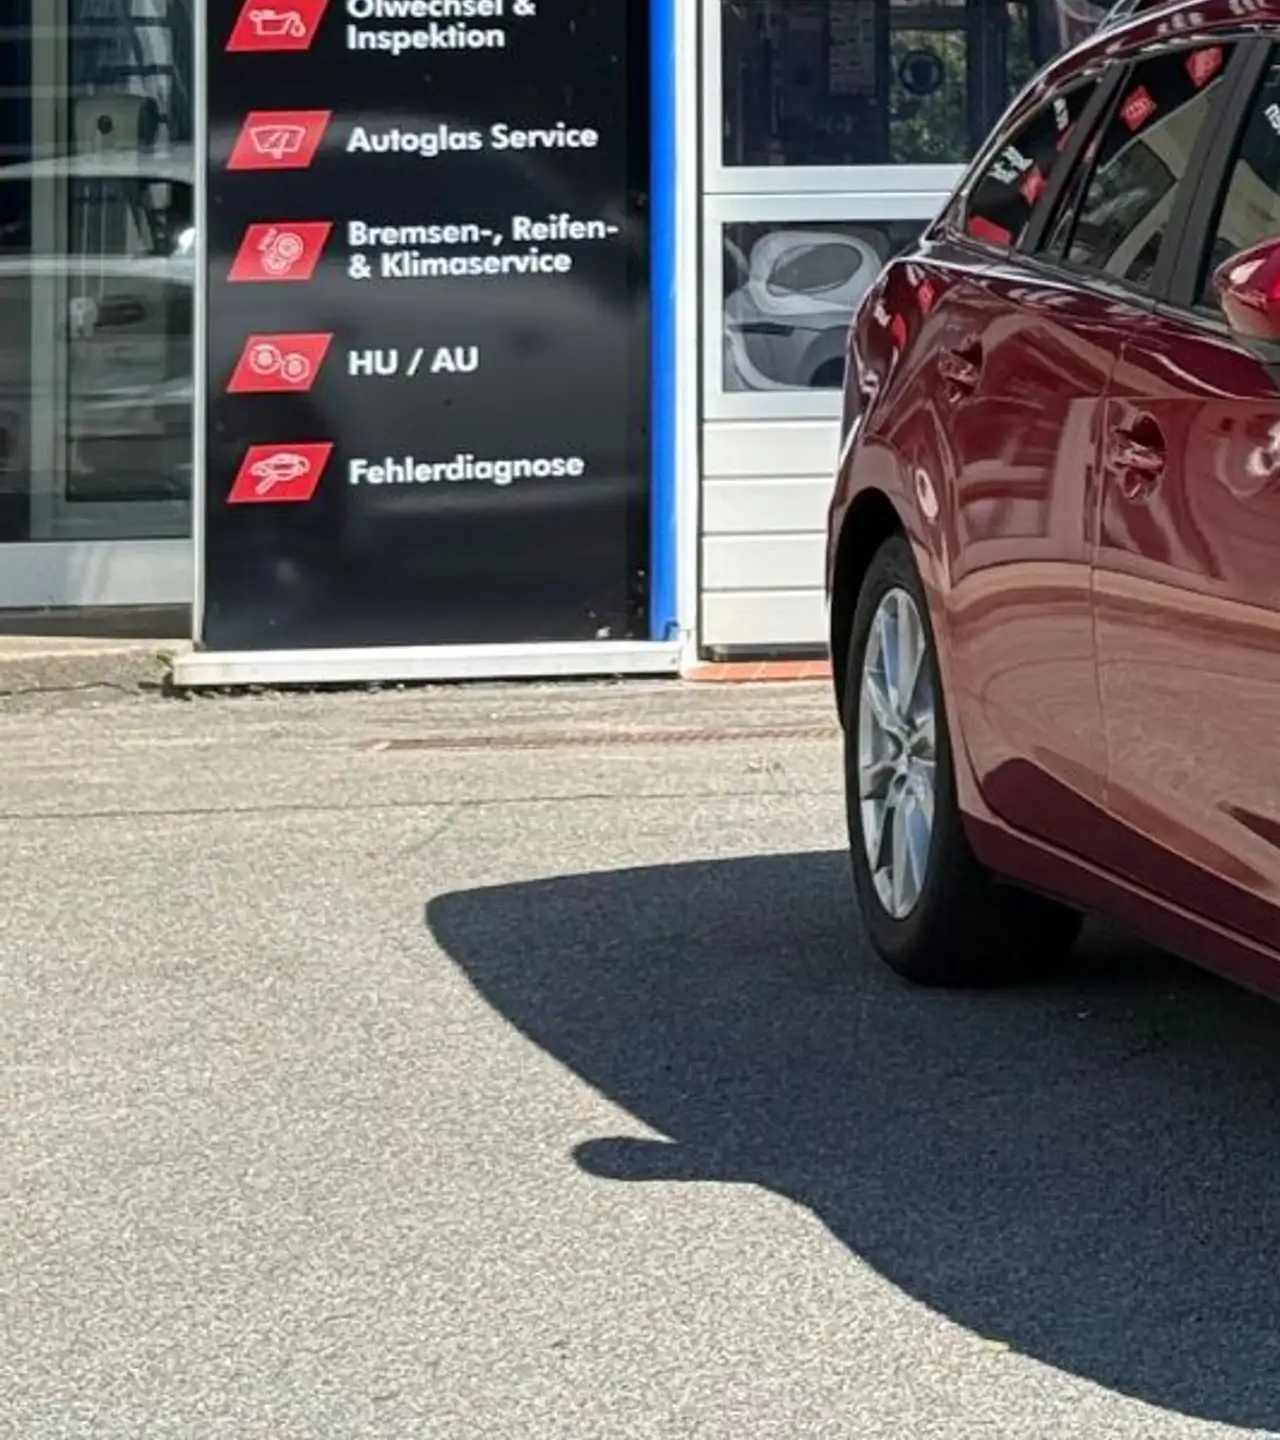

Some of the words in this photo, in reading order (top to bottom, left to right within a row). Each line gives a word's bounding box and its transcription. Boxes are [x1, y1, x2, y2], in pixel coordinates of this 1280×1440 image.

[347, 22, 505, 56] Inspektion
[346, 124, 483, 157] Autoglas
[490, 121, 599, 150] Service
[348, 220, 503, 246] Bremsen-,
[512, 213, 619, 241] Reifen-
[347, 253, 372, 280] &
[381, 247, 572, 278] Klimaservice
[349, 349, 398, 376] HU
[406, 348, 424, 376] /
[431, 346, 479, 373] AU
[349, 454, 585, 485] Fehlerdiagnose
